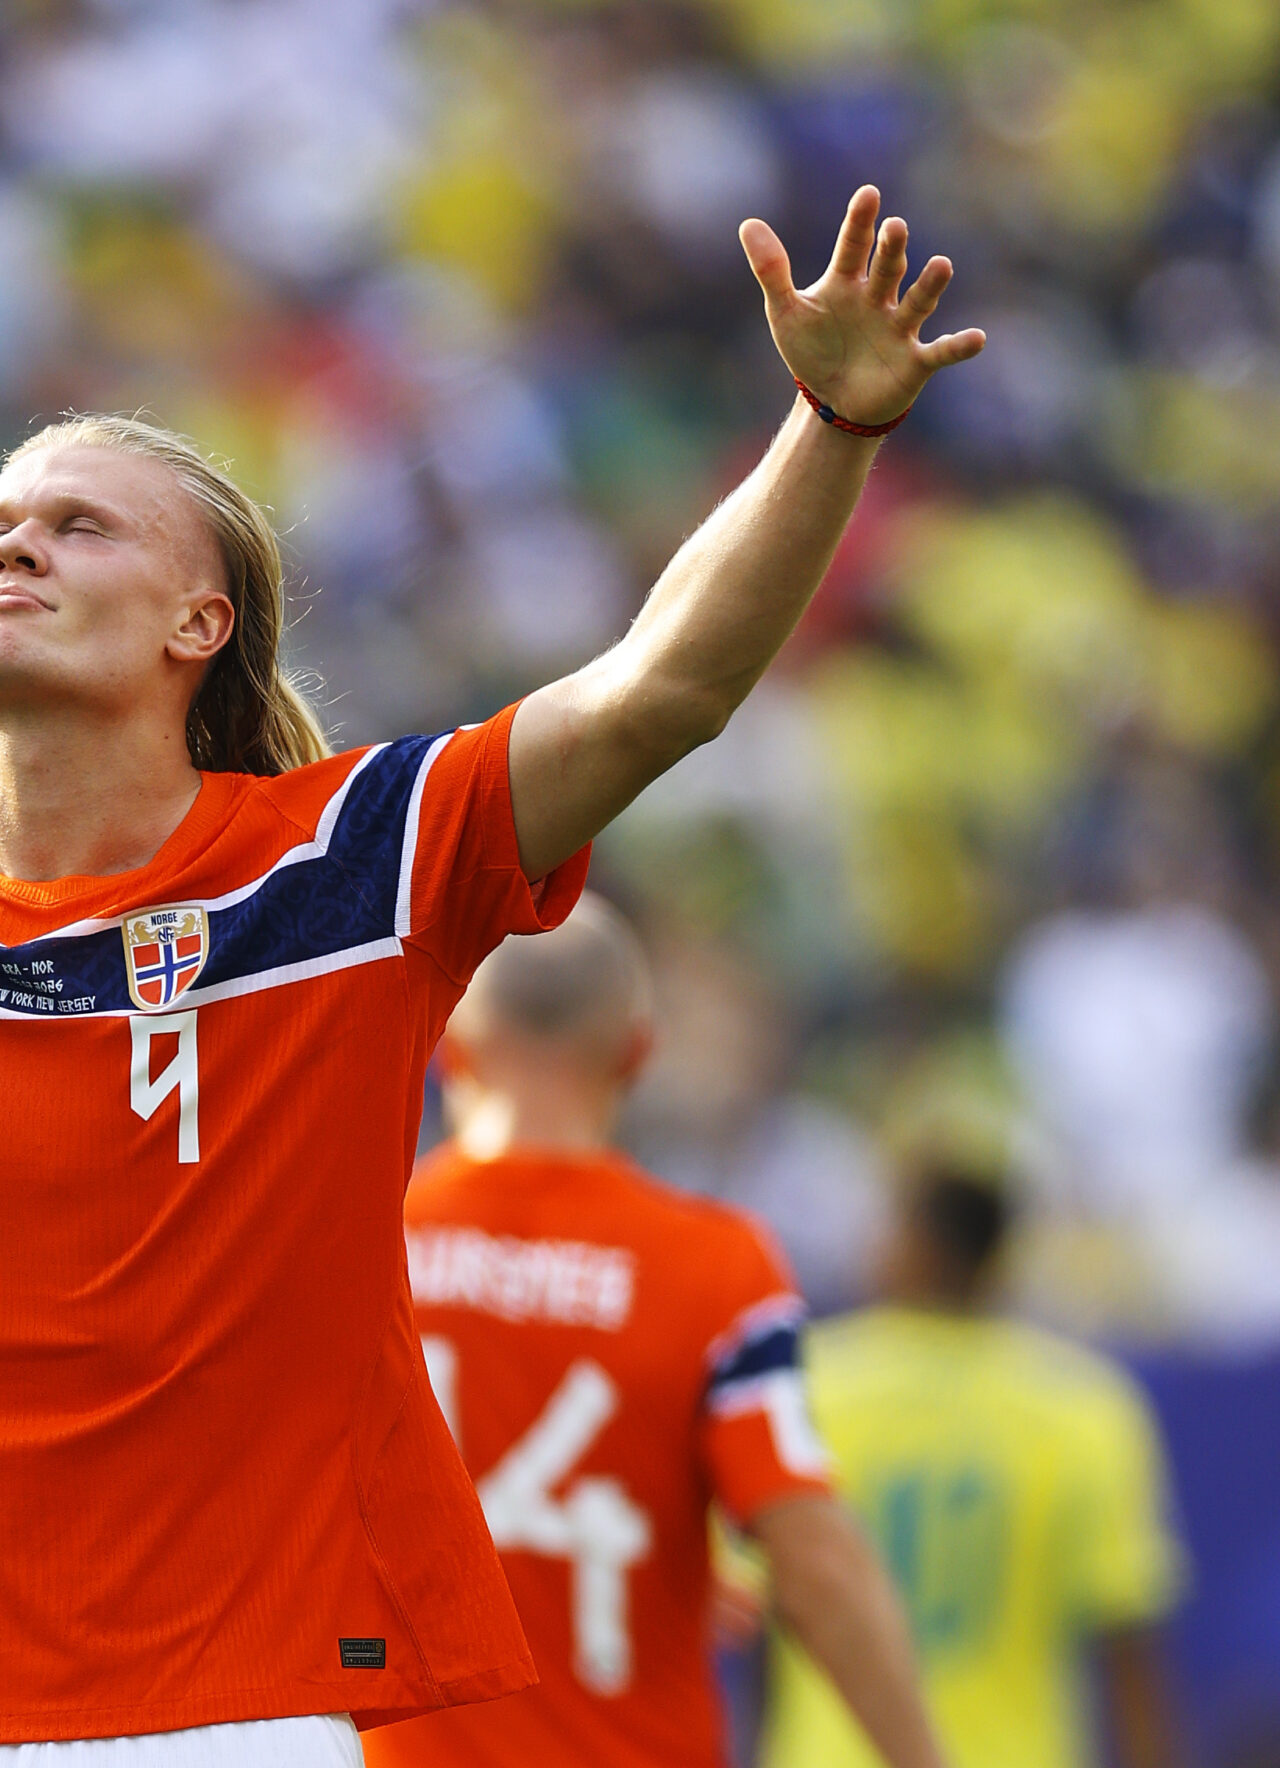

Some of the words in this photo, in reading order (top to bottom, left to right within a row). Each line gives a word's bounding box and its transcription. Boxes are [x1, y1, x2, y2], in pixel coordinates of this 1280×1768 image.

[150, 912, 178, 926] NORGE
[31, 959, 55, 975] NOR
[10, 990, 36, 1008] YORK
[36, 996, 55, 1011] NEW
[56, 995, 97, 1013] JERSEY
[129, 1009, 200, 1164] 9
